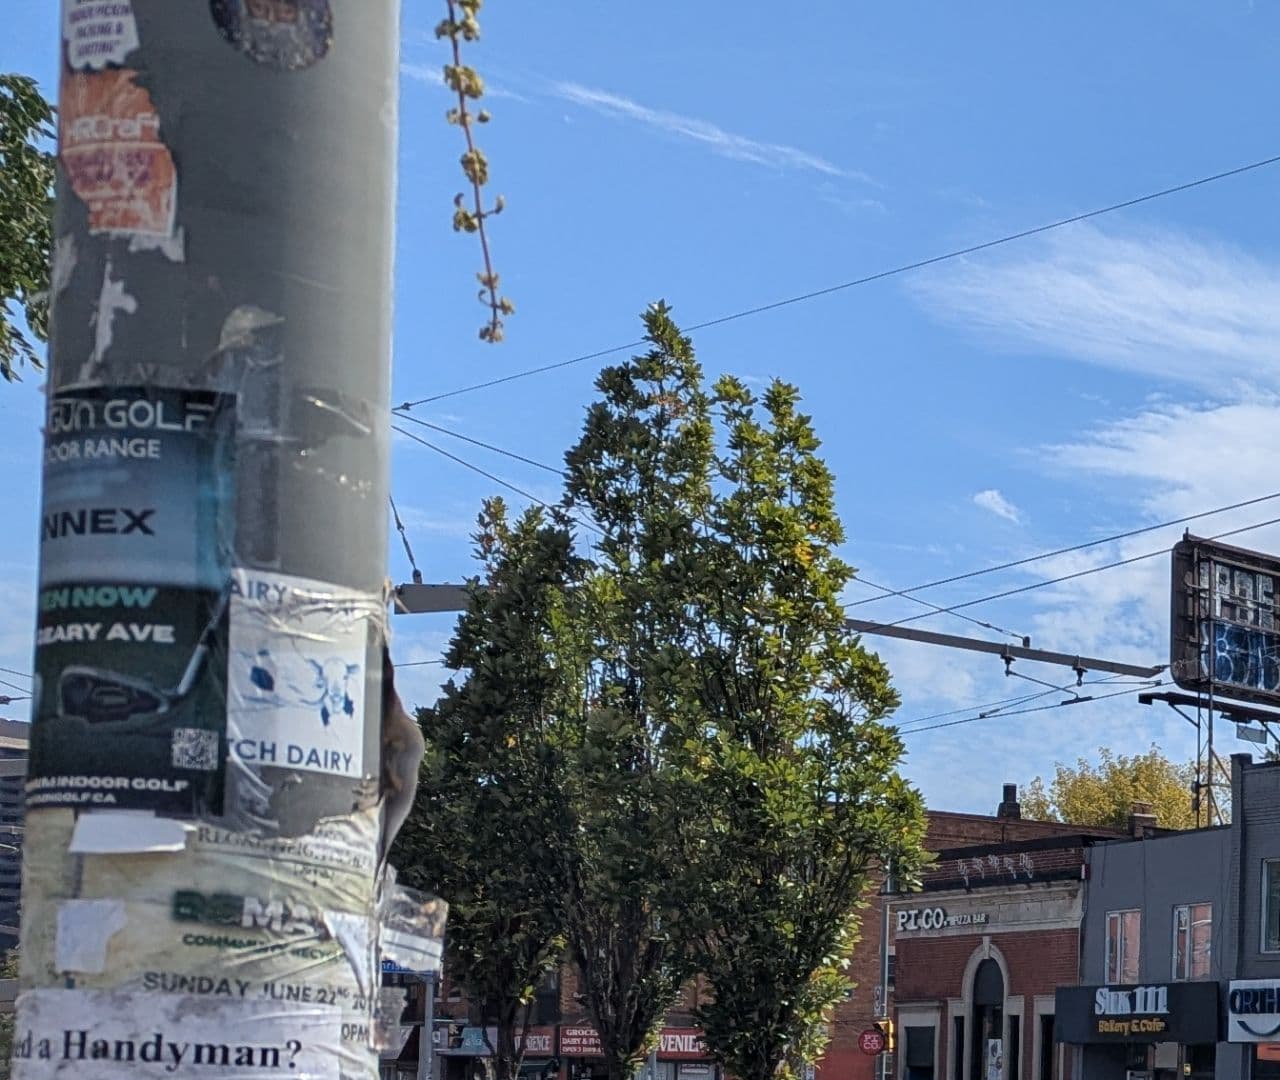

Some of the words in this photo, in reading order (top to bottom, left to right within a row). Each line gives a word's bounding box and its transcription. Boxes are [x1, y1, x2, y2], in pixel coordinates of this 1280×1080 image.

[103, 399, 215, 432] GOLF
[84, 438, 161, 459] RANGE
[72, 586, 157, 609] NOW
[106, 624, 176, 644] AVE
[287, 745, 353, 773] DAIRY
[132, 777, 190, 792] GOLF
[143, 971, 251, 997] SUNDAY
[261, 982, 312, 1001] JUNE
[1099, 1020, 1129, 1036] Bakery
[1131, 1019, 1140, 1032] &
[38, 1039, 50, 1059] a
[62, 1030, 303, 1072] Handyman?
